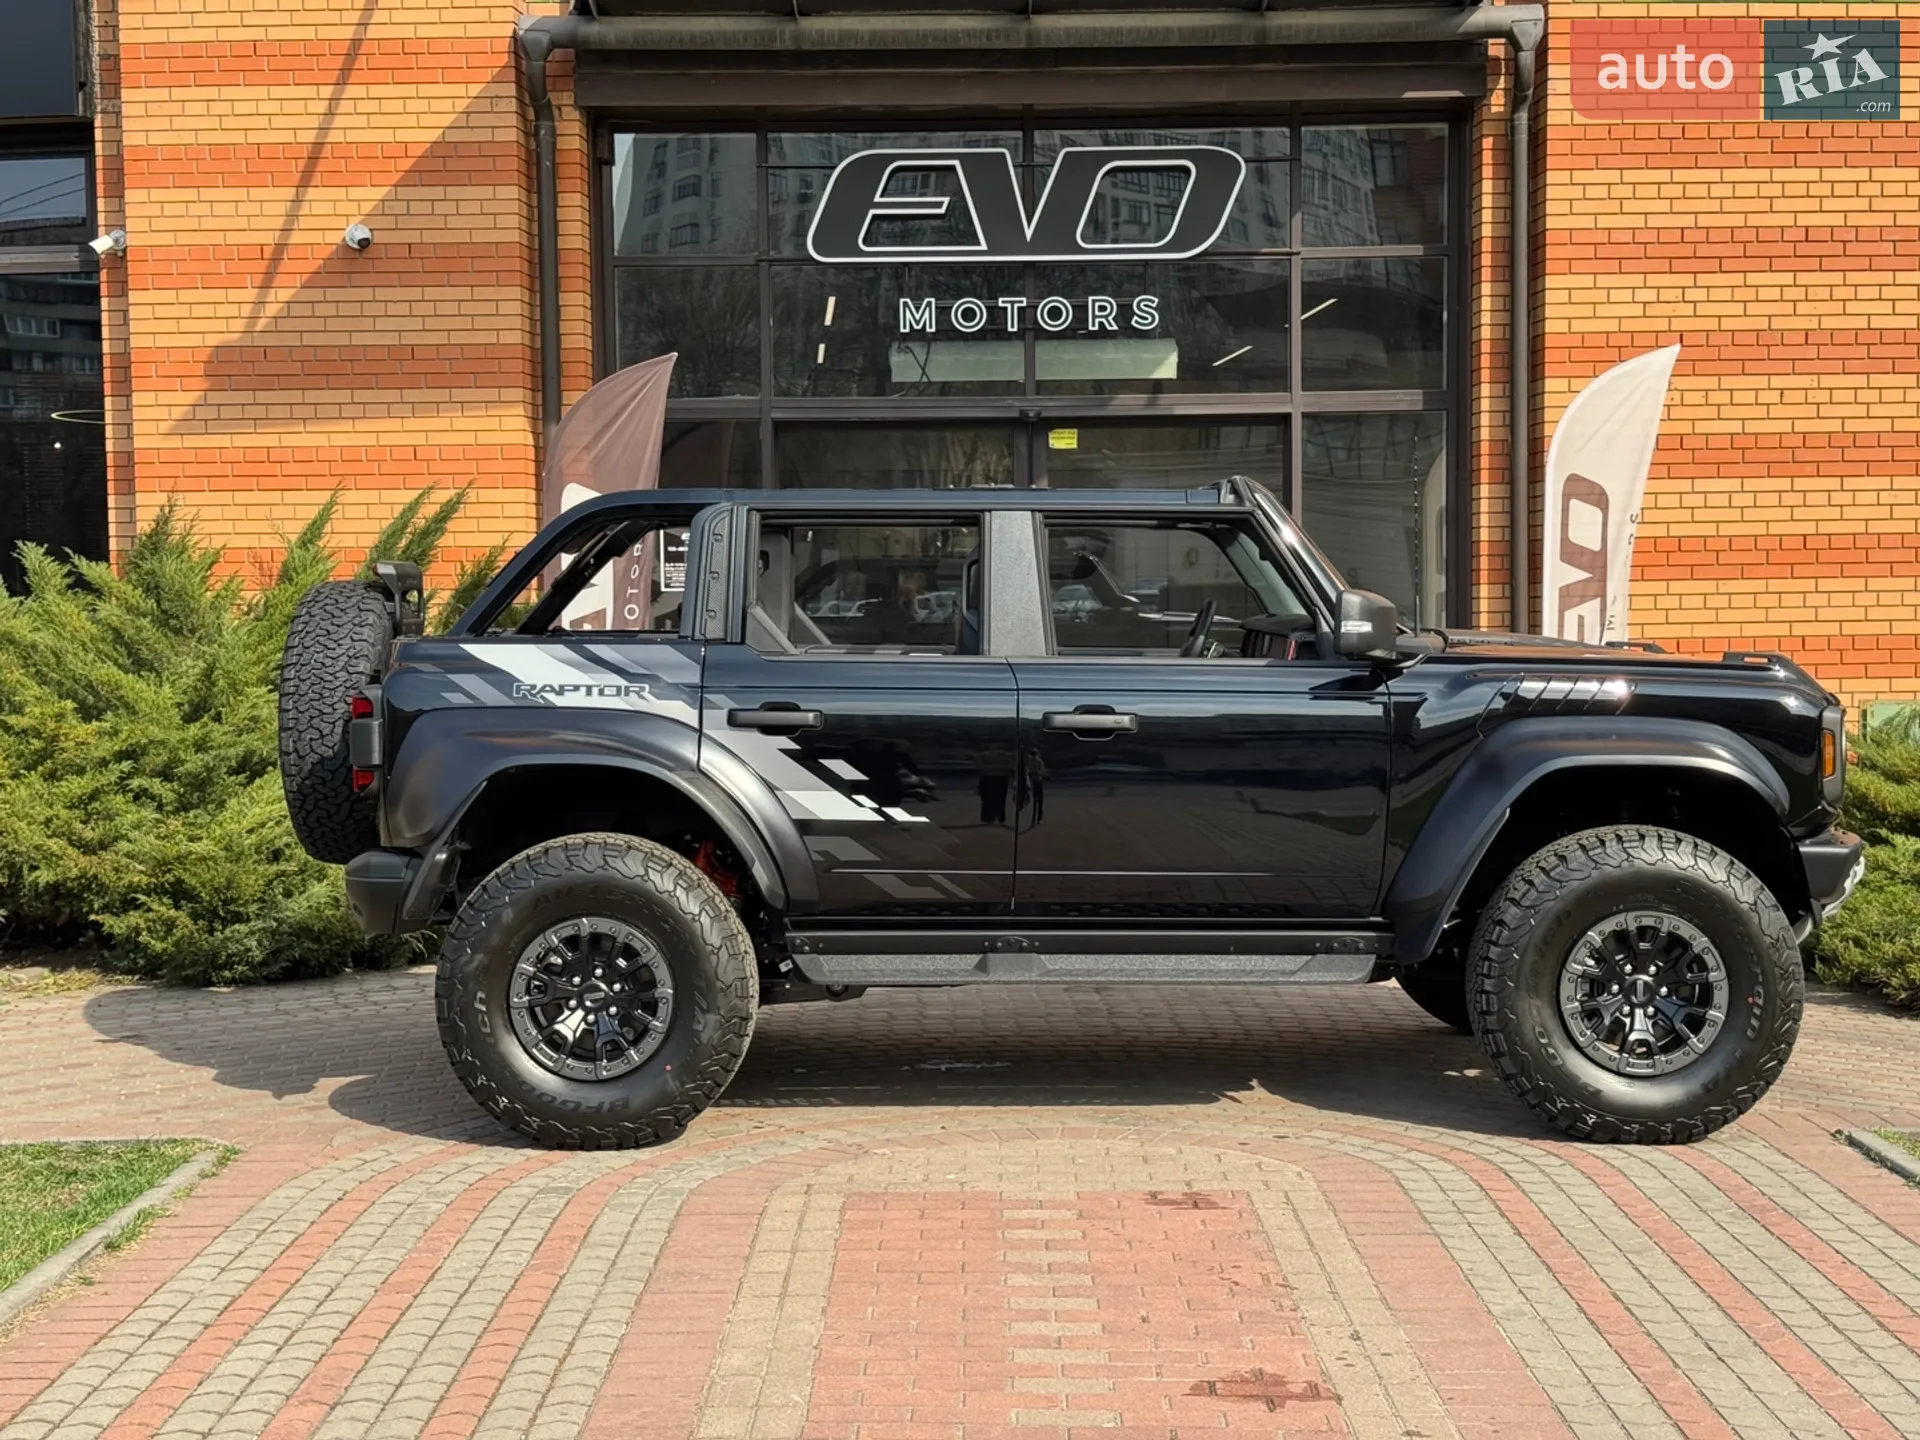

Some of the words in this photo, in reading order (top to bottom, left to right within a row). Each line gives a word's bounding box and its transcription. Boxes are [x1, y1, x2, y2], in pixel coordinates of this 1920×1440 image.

[806, 145, 1247, 262] EVO
[899, 295, 1160, 333] MOTORS
[624, 541, 645, 629] OTOR
[513, 682, 651, 704] RAPTOR
